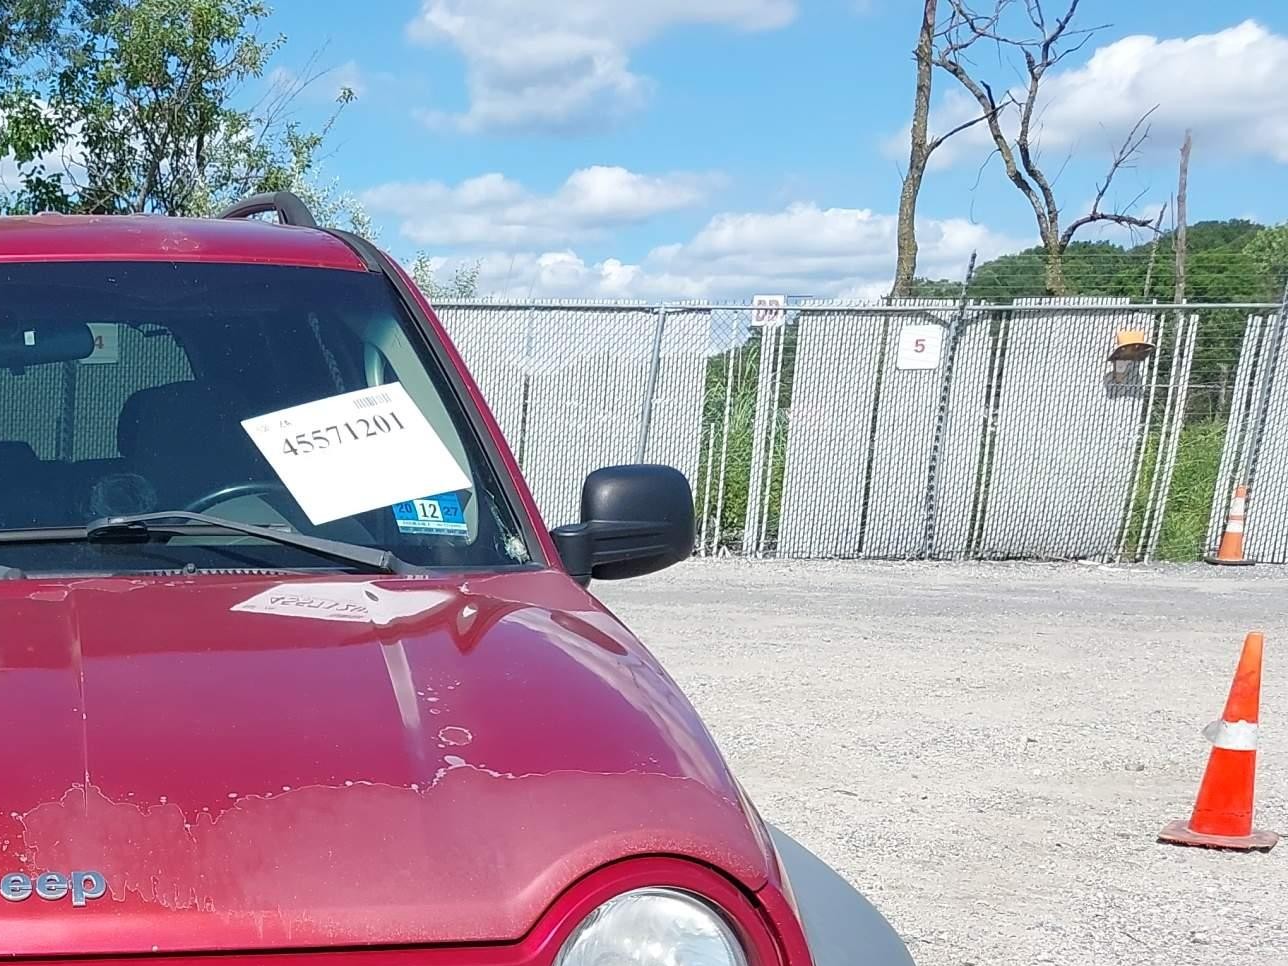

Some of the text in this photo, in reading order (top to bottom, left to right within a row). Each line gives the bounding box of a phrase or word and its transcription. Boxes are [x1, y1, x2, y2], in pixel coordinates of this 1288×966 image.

[94, 335, 105, 350] 4
[913, 338, 927, 354] 5
[282, 411, 405, 456] 45571201
[418, 502, 440, 519] 12
